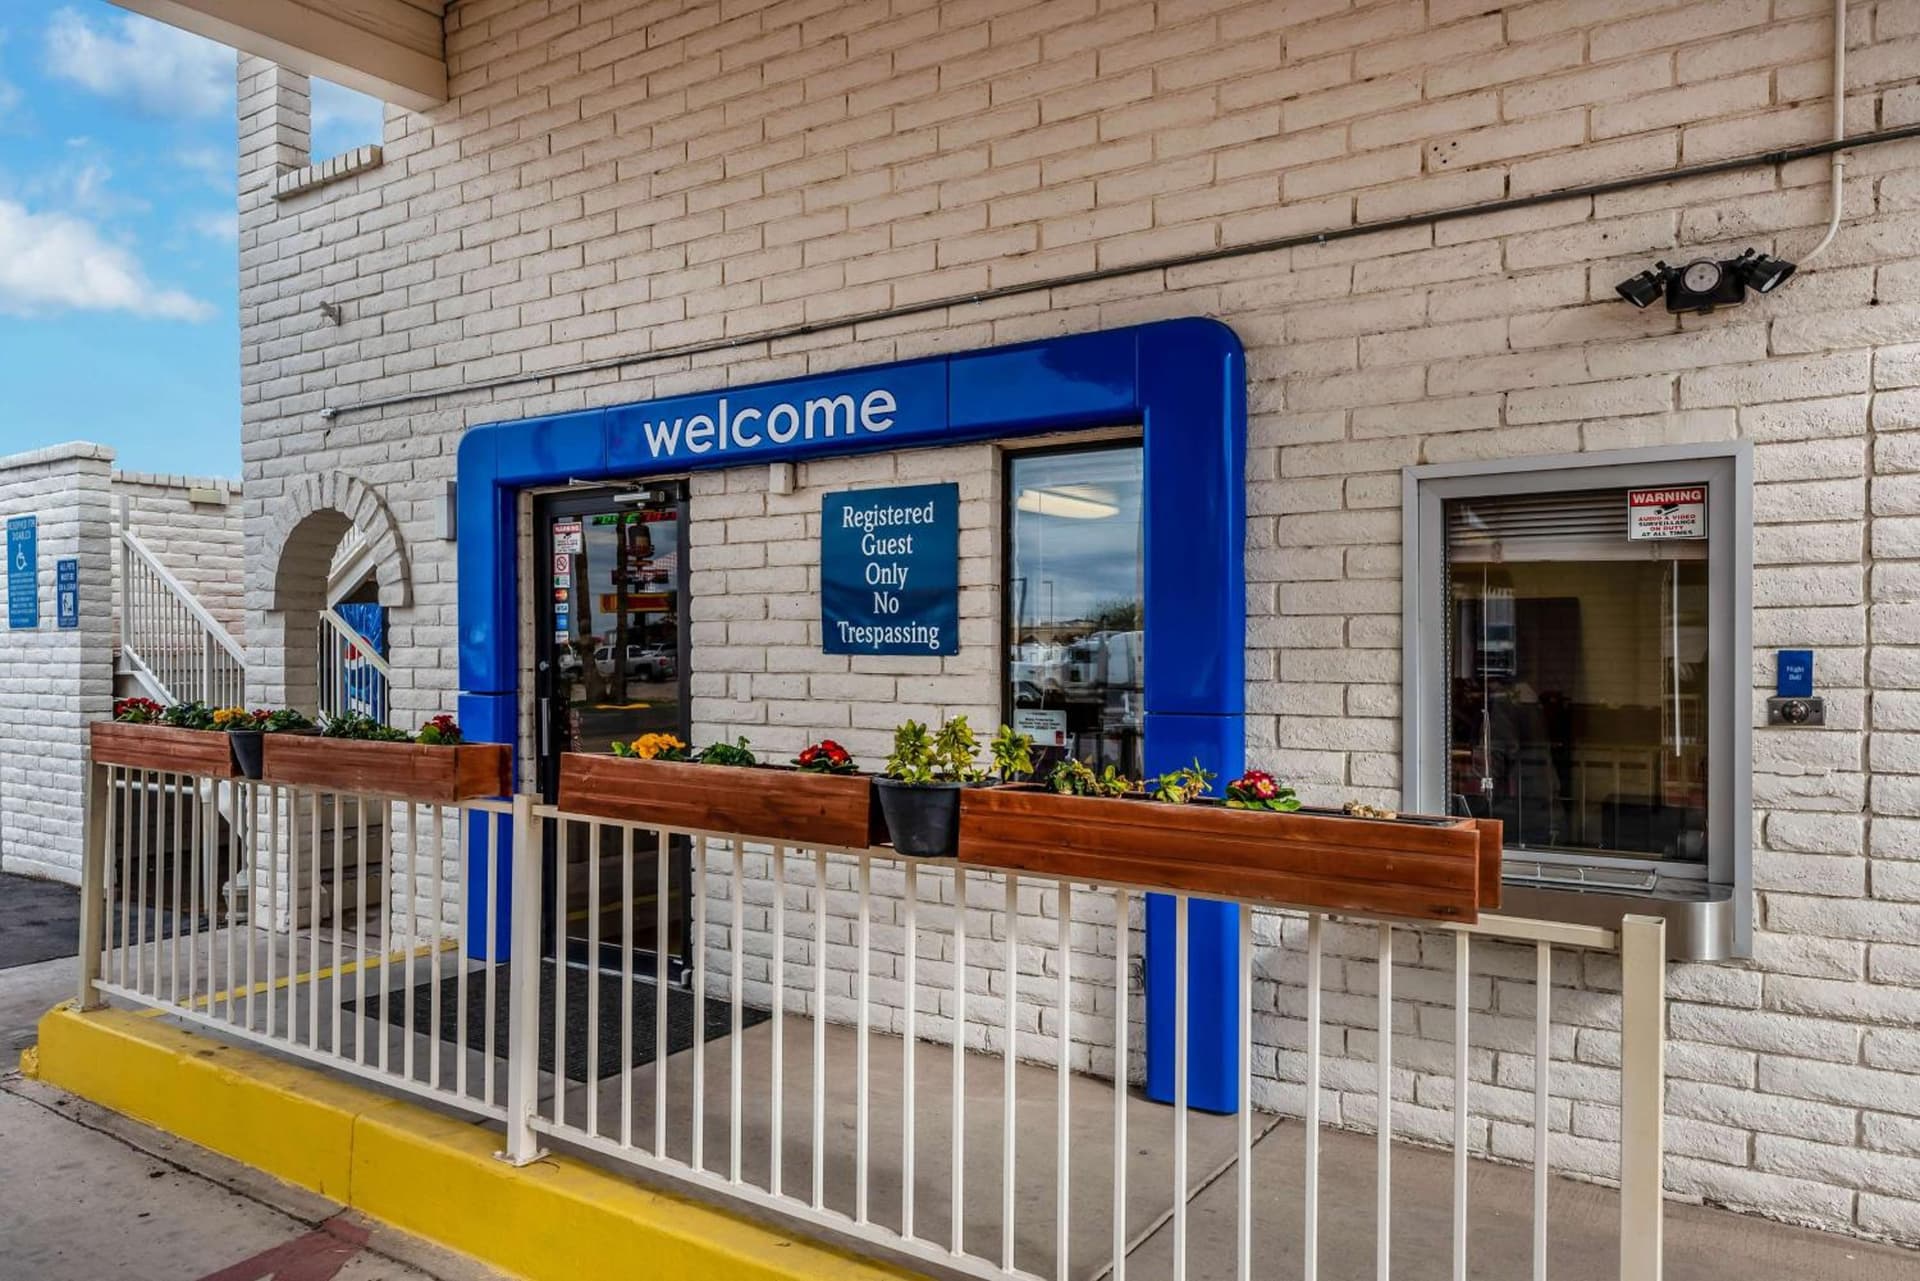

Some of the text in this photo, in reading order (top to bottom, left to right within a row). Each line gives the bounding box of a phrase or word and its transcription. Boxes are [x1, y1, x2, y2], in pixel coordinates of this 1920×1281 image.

[643, 389, 897, 457] welcome
[1632, 490, 1702, 504] WARNING
[842, 501, 935, 532] Registered
[861, 533, 913, 556] Guest
[865, 562, 909, 590] Only
[873, 591, 900, 614] No
[837, 621, 940, 649] Trespassing
